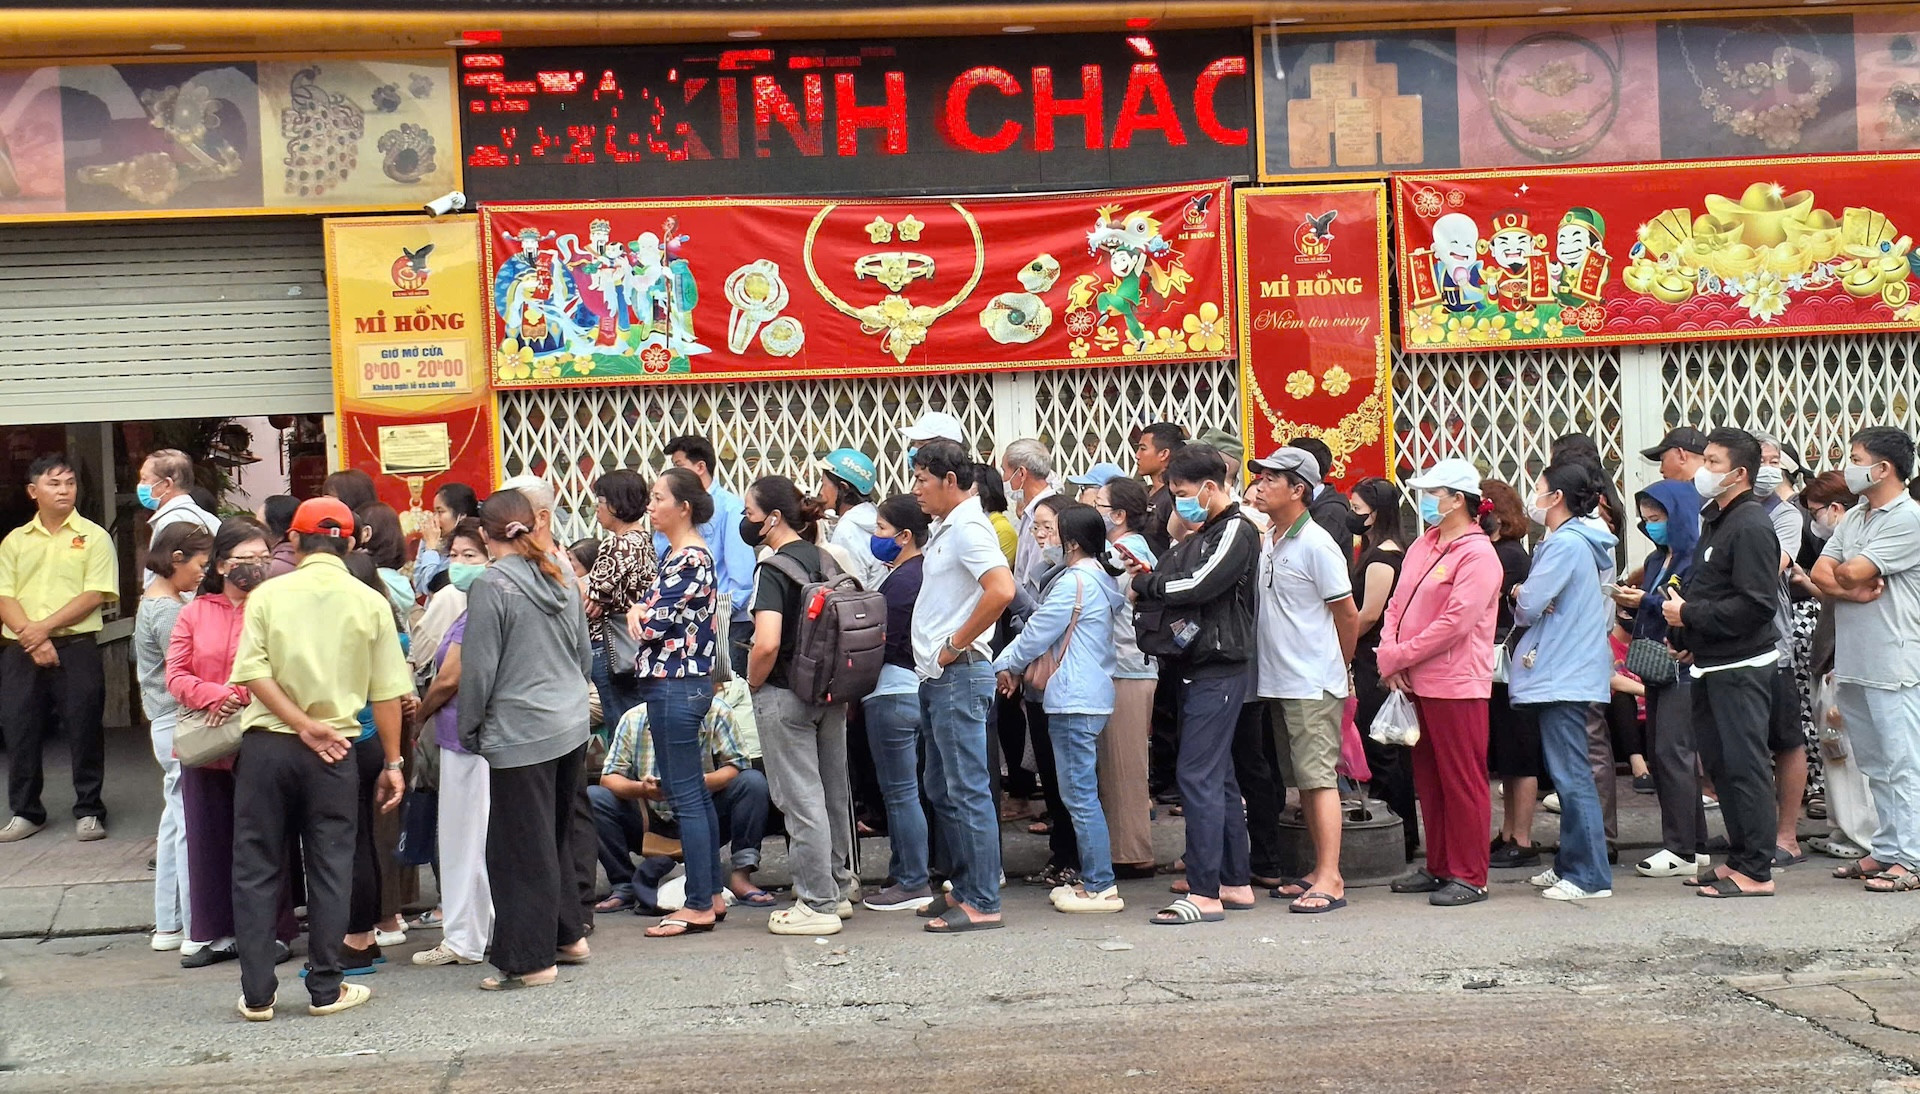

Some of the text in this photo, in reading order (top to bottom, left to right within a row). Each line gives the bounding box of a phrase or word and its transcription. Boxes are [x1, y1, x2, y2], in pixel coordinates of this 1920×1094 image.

[1296, 269, 1363, 296] HỒNG
[393, 304, 465, 332] HỒNG
[1254, 309, 1370, 334] Niềm tin vàng
